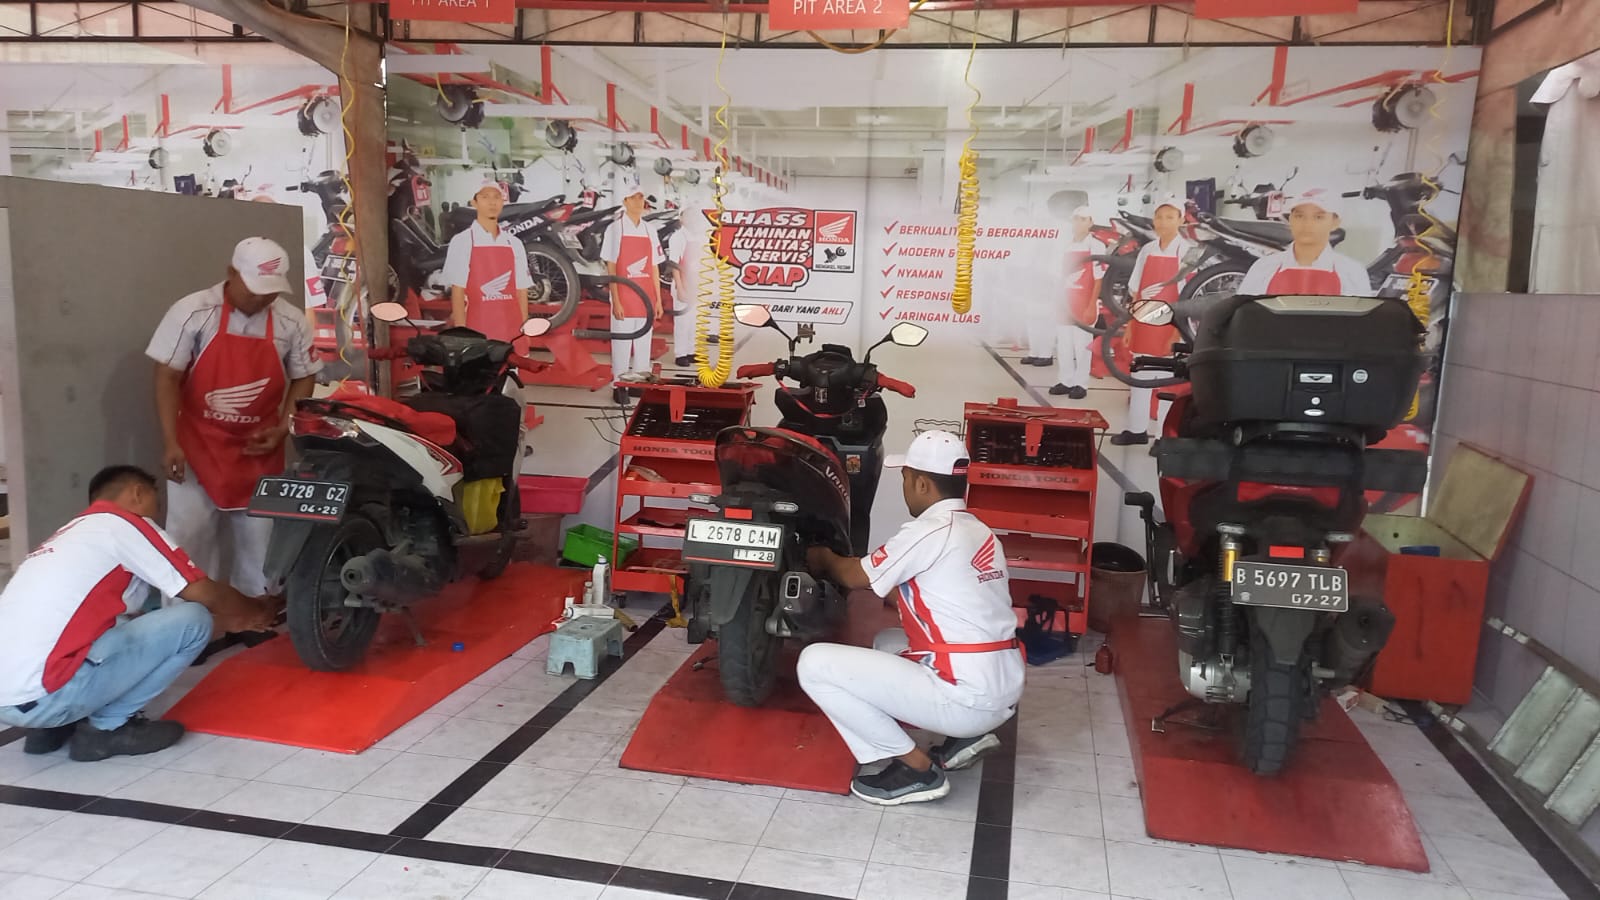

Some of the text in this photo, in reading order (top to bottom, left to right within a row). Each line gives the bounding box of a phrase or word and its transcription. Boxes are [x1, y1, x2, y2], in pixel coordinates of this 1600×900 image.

[793, 0, 882, 15] PIT AREA 2
[720, 211, 808, 226] AHASS
[508, 216, 545, 235] ONDA
[899, 225, 959, 236] BERKUALIT
[987, 228, 1059, 239] BERGARANSI
[735, 227, 812, 239] JAMINAN
[732, 238, 811, 251] KUALITAS
[750, 250, 808, 263] SERVIS
[898, 247, 945, 257] MODERN
[948, 249, 955, 257] &
[742, 265, 805, 287] SIAP
[897, 269, 943, 279] NYAMAN
[771, 305, 794, 313] DARI
[795, 306, 821, 314] YANG
[821, 307, 845, 315] AHLI
[895, 311, 981, 324] JARINGAN LUAS
[633, 445, 678, 454] HONDA
[980, 472, 1030, 481] HONDA
[260, 482, 346, 502] L 3728 CZ
[691, 524, 778, 546] L 2678 CAM
[1236, 568, 1342, 592] B 5697 TLB
